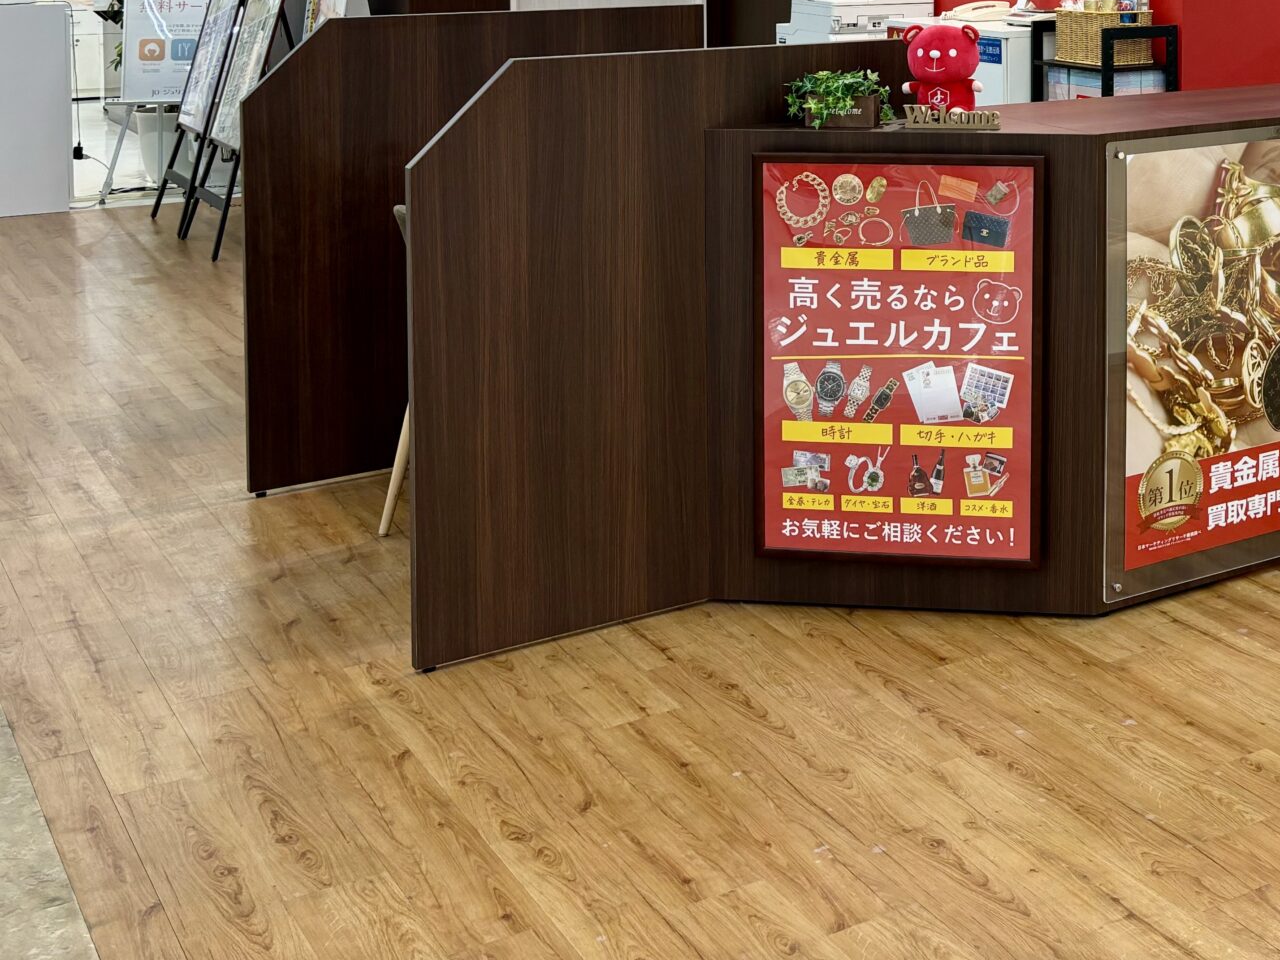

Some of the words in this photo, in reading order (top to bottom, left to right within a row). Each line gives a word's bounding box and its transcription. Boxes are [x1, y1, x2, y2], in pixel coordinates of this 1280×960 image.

[139, 0, 209, 14] 料サー
[903, 105, 1000, 127] Welcome
[814, 251, 860, 267] 貴金属
[926, 254, 989, 268] ブランド品
[788, 276, 965, 312] 高く売るなら
[776, 313, 1019, 352] ジュエルカフェ
[821, 426, 852, 440] 時計
[916, 428, 997, 444] 切手・ハガキ
[1148, 468, 1194, 507] 第1位
[844, 499, 890, 509] ダイヤ・宝石
[916, 501, 937, 511] 洋酒
[965, 504, 1009, 514] コスメ・香水
